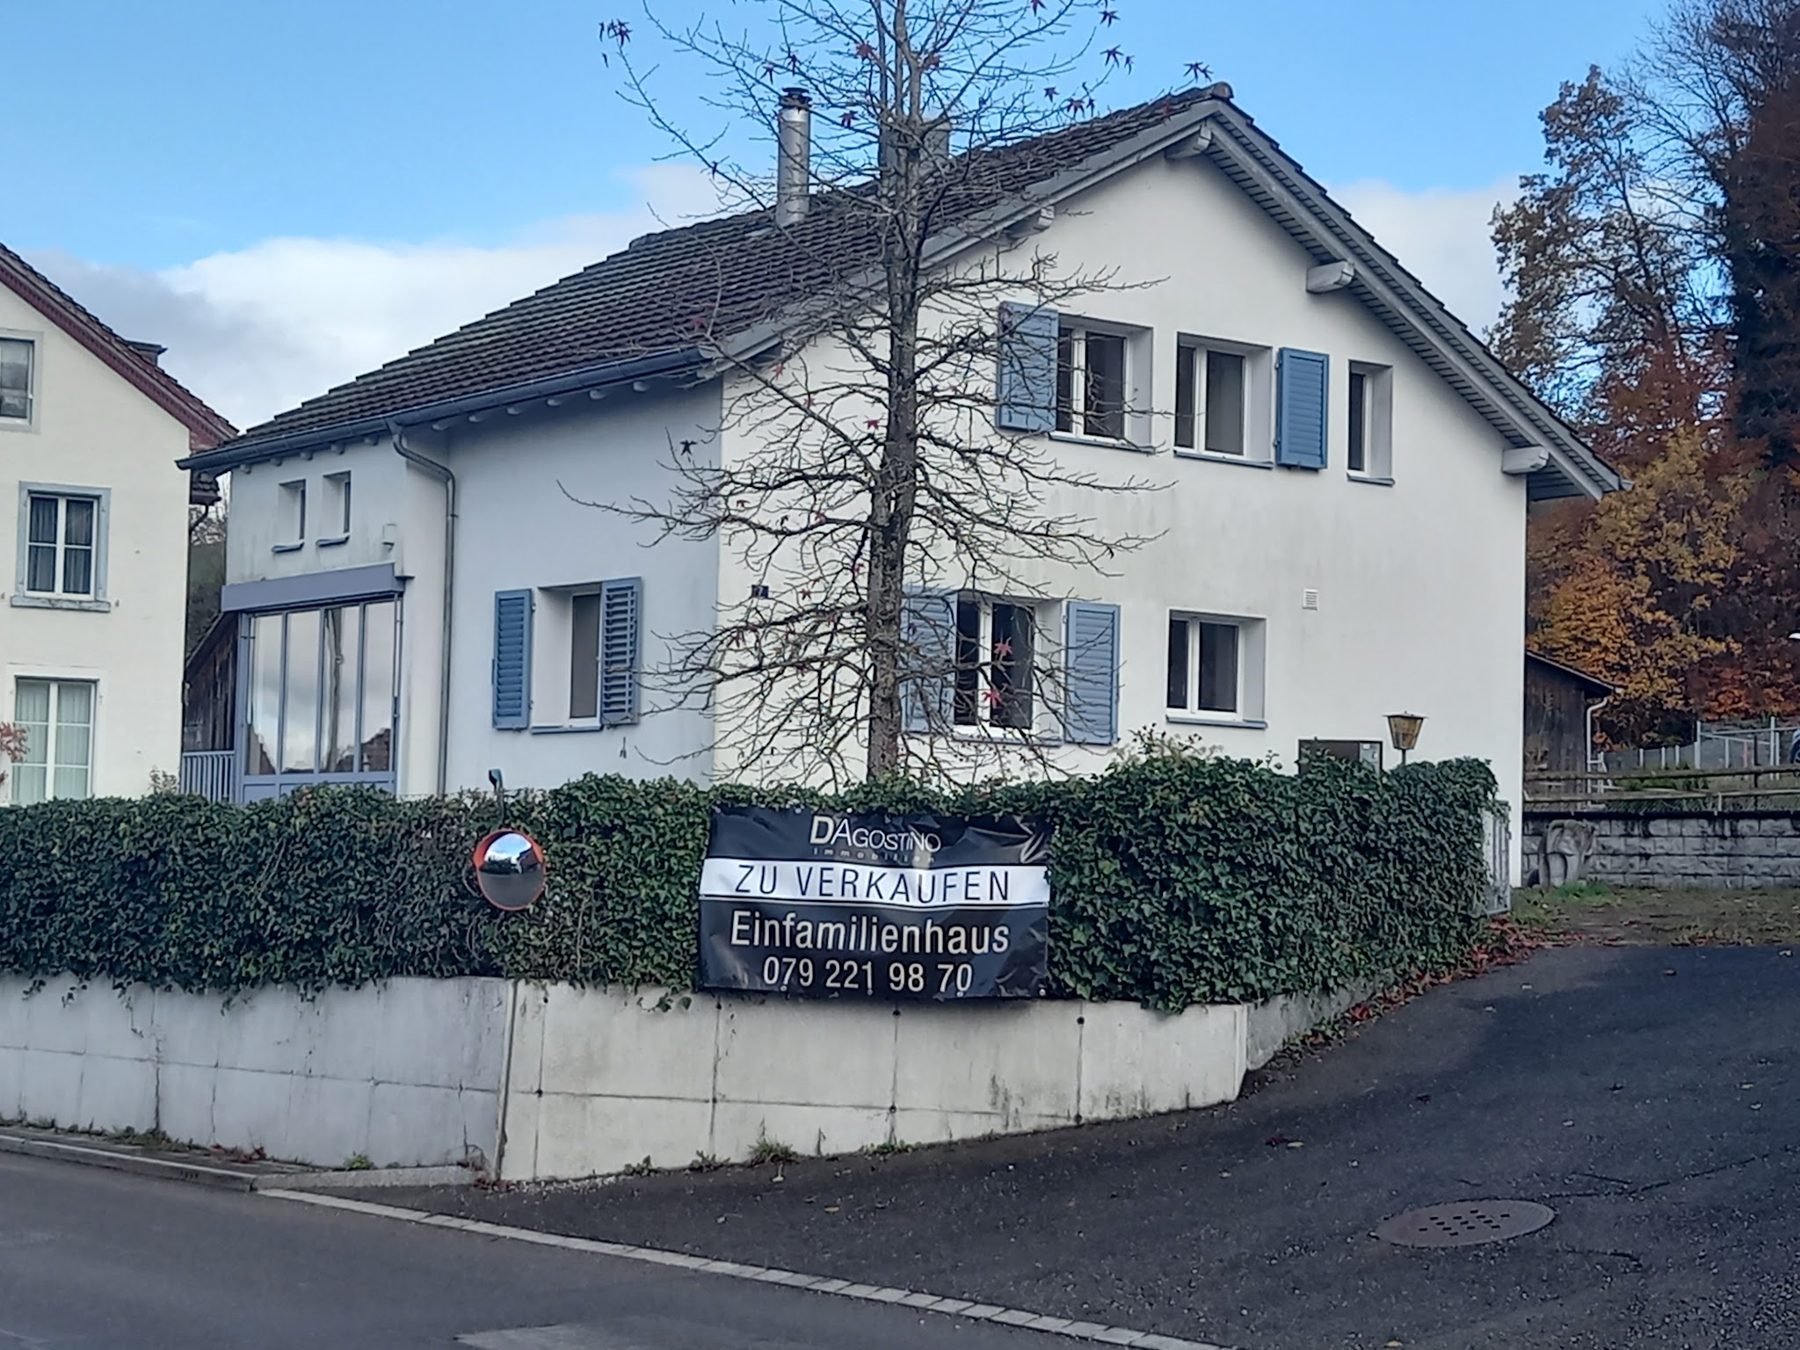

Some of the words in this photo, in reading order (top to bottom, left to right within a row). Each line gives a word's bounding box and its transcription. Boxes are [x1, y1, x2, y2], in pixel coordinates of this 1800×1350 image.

[735, 864, 778, 894] ZU
[796, 867, 1009, 903] VERKAUFEN
[730, 910, 1009, 954] Einfamilienhaus
[763, 956, 814, 987] 079
[825, 960, 874, 990] 221
[889, 963, 925, 991] 98
[937, 963, 973, 992] 70
